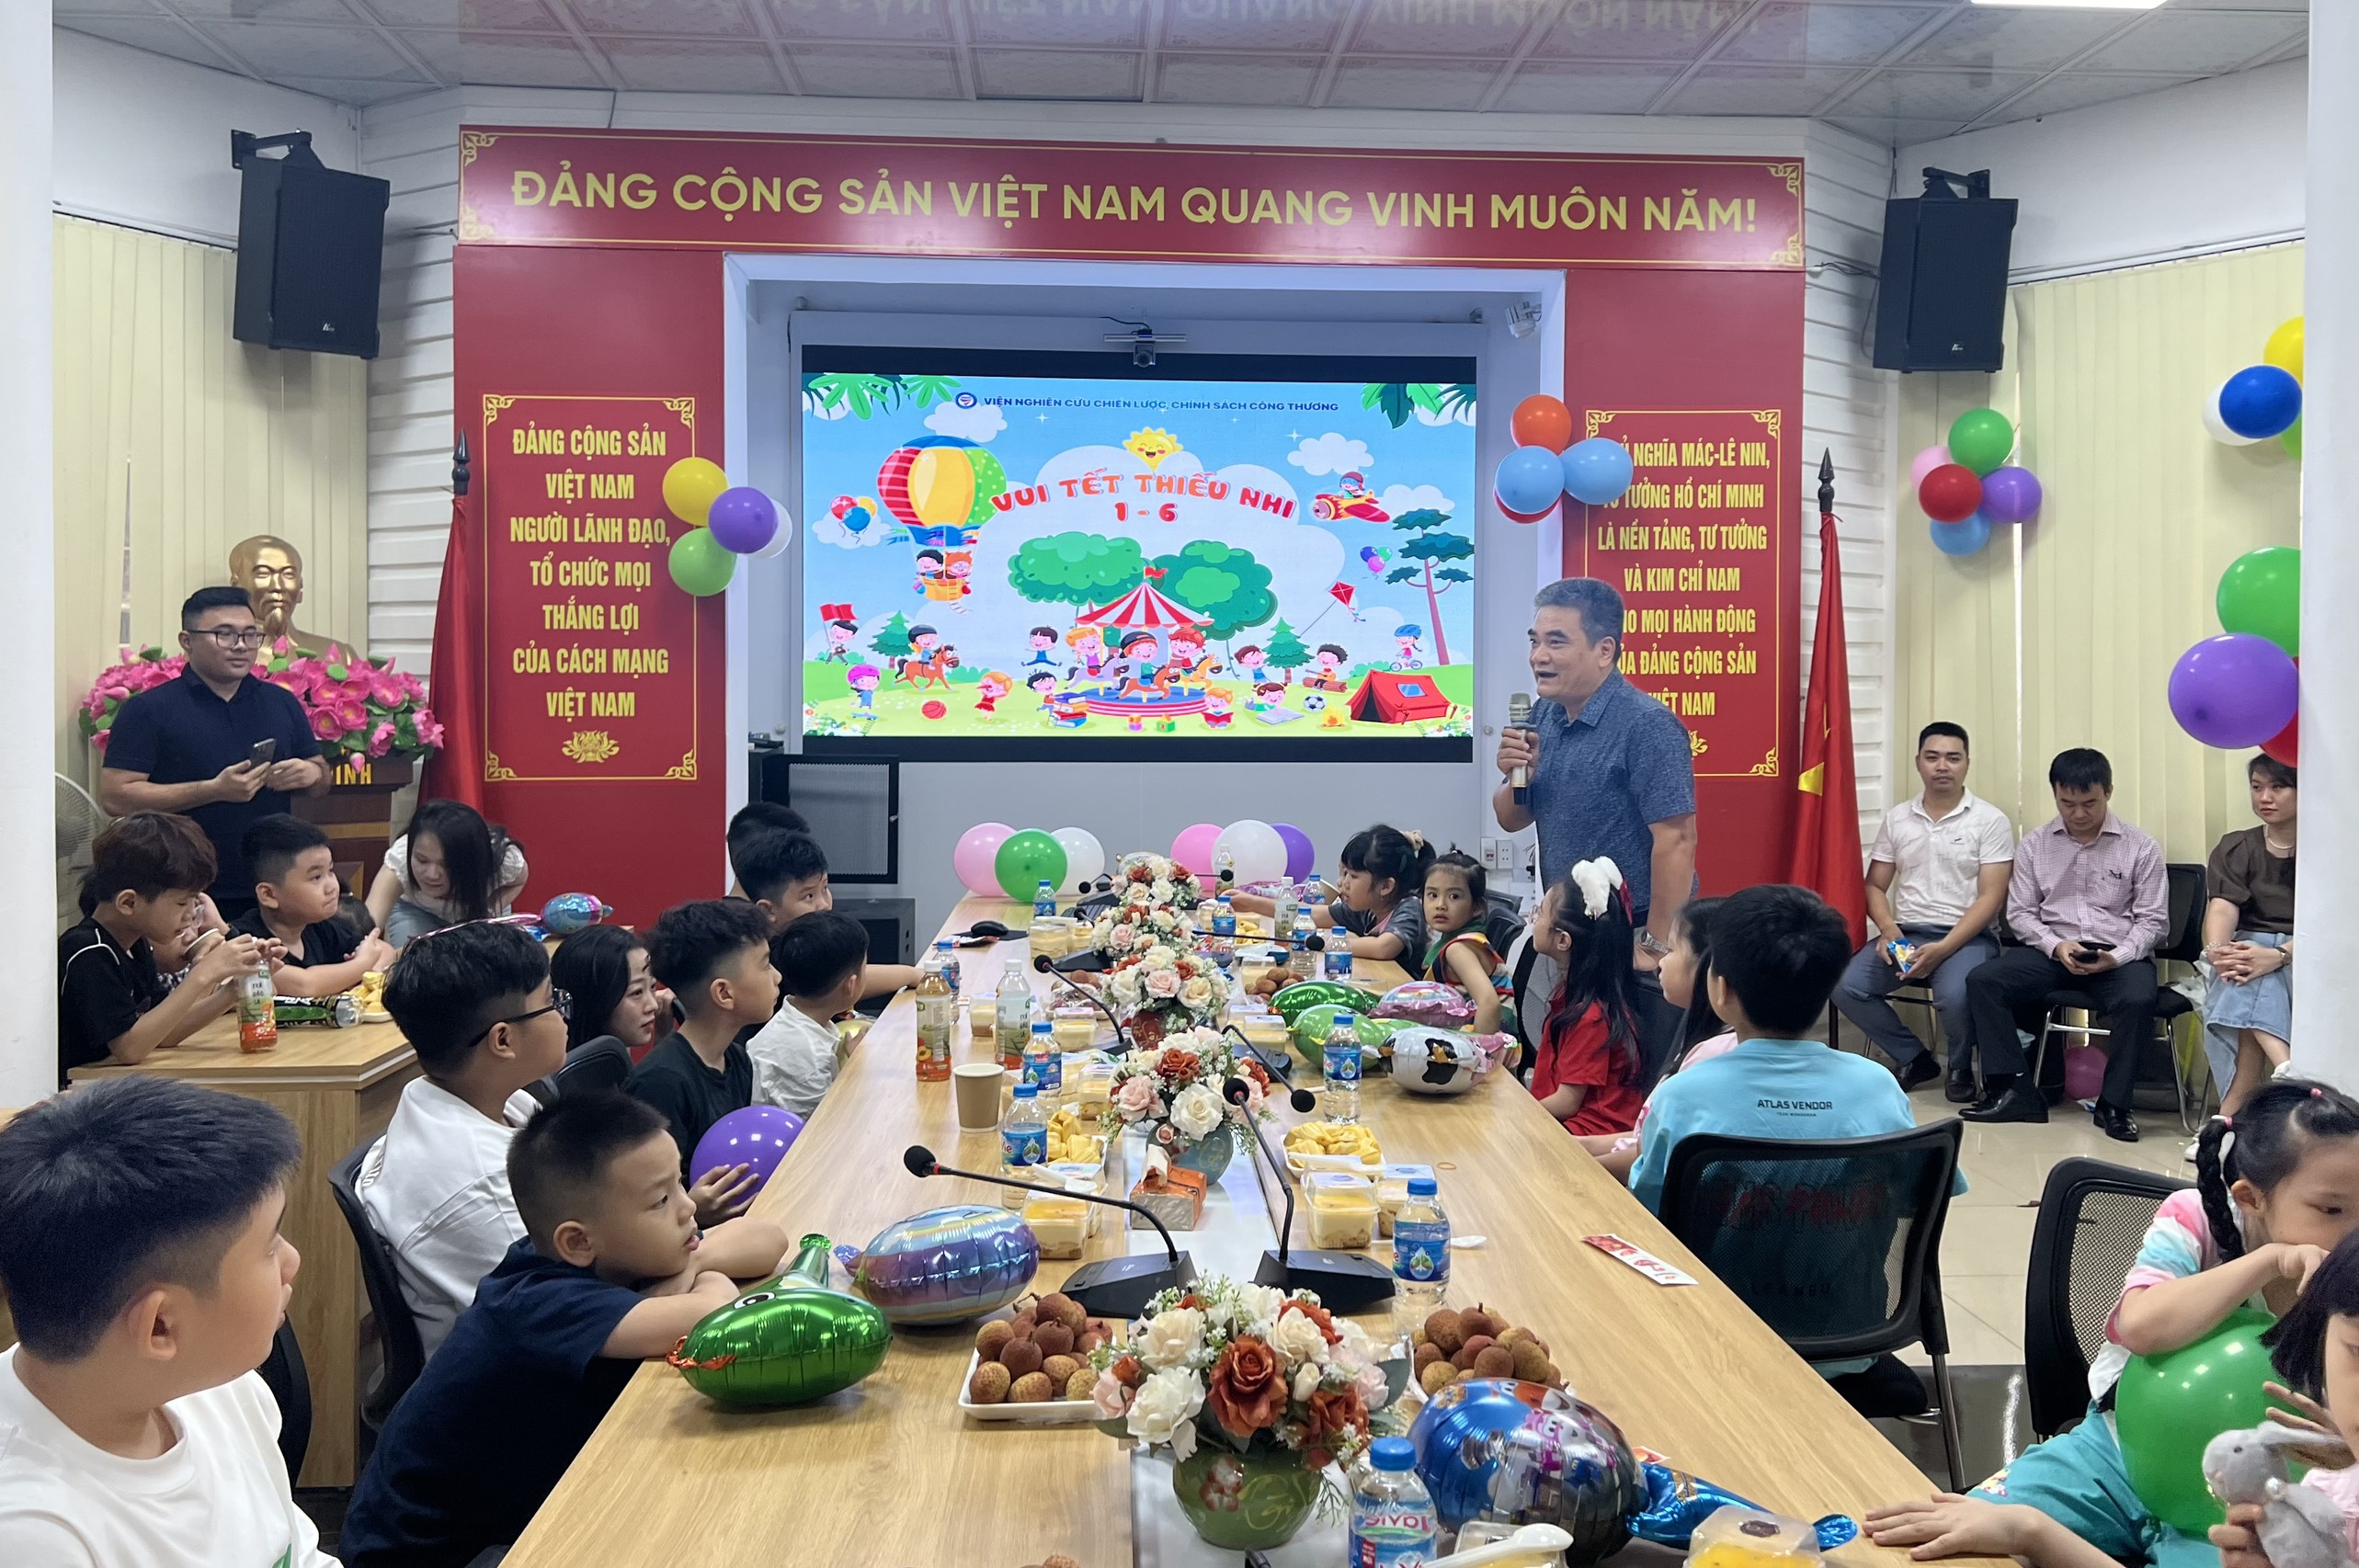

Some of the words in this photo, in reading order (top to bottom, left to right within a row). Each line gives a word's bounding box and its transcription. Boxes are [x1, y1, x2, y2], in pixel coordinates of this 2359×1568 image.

[509, 161, 656, 212] ĐẢNG
[673, 167, 822, 222] CỘNG
[839, 169, 934, 220] SẢN
[945, 175, 1047, 231] VIỆT
[1064, 185, 1164, 221] NAM
[1182, 187, 1356, 229] QUANG
[1364, 192, 1473, 230] VINH
[1491, 187, 1626, 230] MUÔN
[1645, 189, 1759, 234] NĂM!
[984, 396, 1012, 407] VIỆN
[1015, 397, 1062, 407] NGHIÊN
[1065, 397, 1090, 407] CỨU
[1134, 400, 1169, 410] LƯỢC,
[1171, 399, 1210, 409] CHÍNH
[1214, 399, 1247, 410] SÁCH
[1249, 400, 1284, 411] CÔNG
[1287, 402, 1339, 411] THƯƠNG
[513, 421, 564, 454] ĐẢNG
[571, 425, 621, 460] CỘNG
[628, 423, 666, 456] SẢN
[1633, 438, 1678, 466] NGHĨA
[1682, 437, 1736, 466] MÁC-LÊ
[1740, 442, 1770, 469] NIN,
[546, 469, 585, 504] VIỆT
[591, 474, 633, 499] NAM
[991, 485, 1049, 512] VUI
[1059, 468, 1123, 497] TẾT
[1134, 472, 1230, 500] THIẾU
[1239, 487, 1296, 519] NHI
[1624, 476, 1670, 508] TƯỞNG
[1675, 476, 1693, 508] HỒ
[1698, 480, 1722, 508] CHÍ
[1726, 484, 1763, 507] MINH
[1114, 502, 1128, 522] 1
[1158, 503, 1178, 522] 6
[510, 511, 567, 542] NGƯỜI
[575, 513, 622, 542] LÃNH
[628, 518, 670, 548] ĐẠO,
[1599, 522, 1615, 550] LÀ
[1620, 519, 1648, 550] NỀN
[1653, 518, 1694, 552] TẢNG,
[1699, 524, 1717, 550] TƯ
[1720, 518, 1767, 550] TƯỞNG
[530, 551, 553, 585] TỔ
[559, 556, 609, 585] CHỨC
[615, 562, 650, 592] MỌI
[1624, 563, 1643, 591] VÀ
[1647, 568, 1674, 591] KIM
[1679, 560, 1703, 591] CHỈ
[1707, 568, 1739, 591] NAM
[542, 596, 604, 630] THẮNG
[610, 603, 638, 635] LỢI
[1642, 609, 1669, 638] MỌI
[1673, 605, 1712, 632] HÀNH
[1716, 604, 1755, 638] ĐỘNG
[514, 641, 551, 673] CỦA
[557, 643, 606, 673] CÁCH
[613, 649, 668, 678] MẠNG
[1618, 643, 1635, 675] ỦA
[1640, 643, 1679, 674] ĐẢNG
[1684, 646, 1722, 679] CỘNG
[1727, 642, 1756, 674] SẢN
[547, 687, 586, 722] VIỆT
[592, 692, 634, 716] NAM
[1682, 692, 1715, 715] NAM
[332, 763, 371, 785] INH
[1758, 1099, 1790, 1109] ATLAS
[1792, 1100, 1832, 1110] VENDOR
